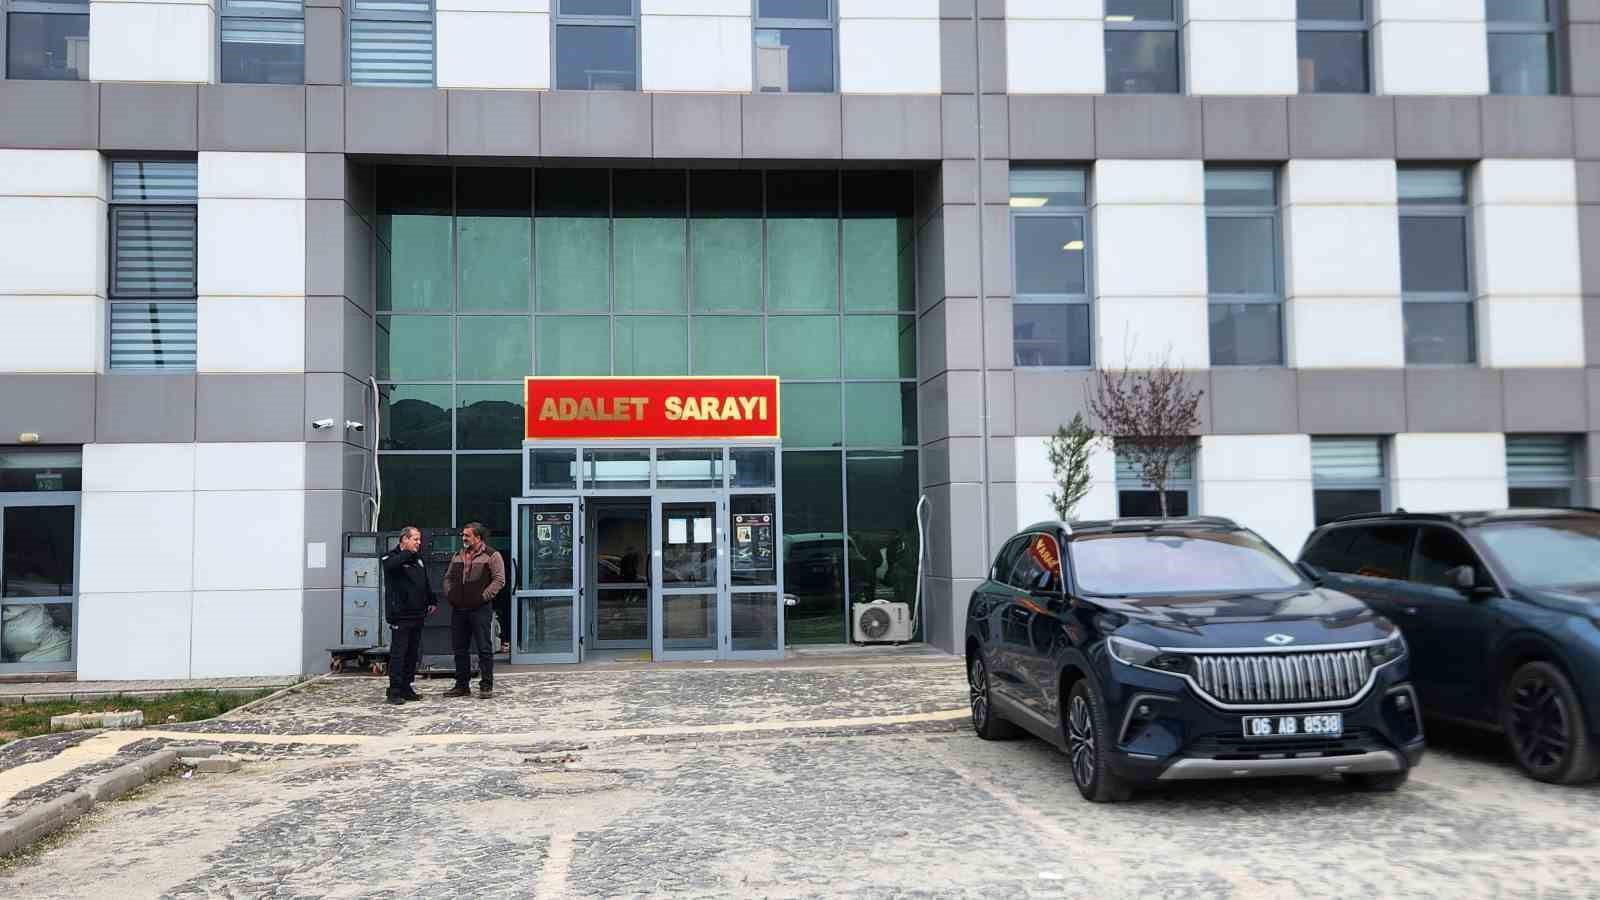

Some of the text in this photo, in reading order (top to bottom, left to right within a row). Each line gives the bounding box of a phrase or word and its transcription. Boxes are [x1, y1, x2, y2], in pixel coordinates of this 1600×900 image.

[539, 396, 768, 421] ADALET SARAYI
[1252, 718, 1272, 735] 06
[1278, 717, 1297, 734] AB
